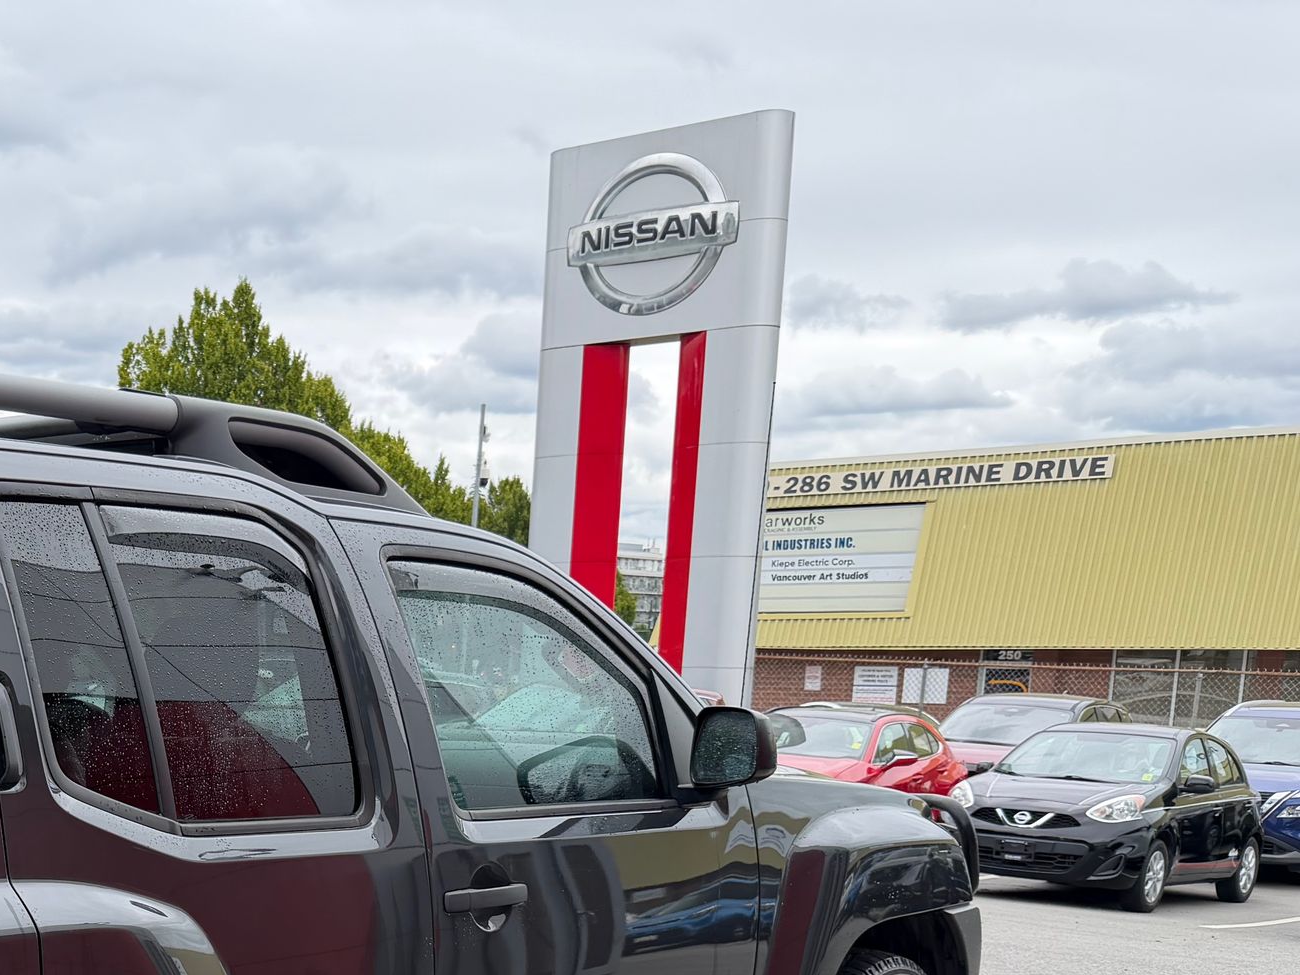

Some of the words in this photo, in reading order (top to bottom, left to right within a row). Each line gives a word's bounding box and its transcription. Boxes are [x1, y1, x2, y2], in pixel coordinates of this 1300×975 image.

[580, 210, 718, 255] NISSAN
[767, 474, 831, 495] -286
[840, 471, 885, 491] SW
[889, 463, 1004, 488] MARINE
[1012, 456, 1110, 481] DRIVE
[772, 537, 831, 550] INDUSTRIES
[835, 536, 855, 548] INC.
[771, 558, 795, 568] Kiepe
[797, 557, 829, 567] Electric
[831, 557, 855, 568] Corp.
[771, 572, 816, 582] Vancouver
[819, 571, 833, 581] Art
[836, 571, 869, 581] Studios
[998, 650, 1022, 660] 250
